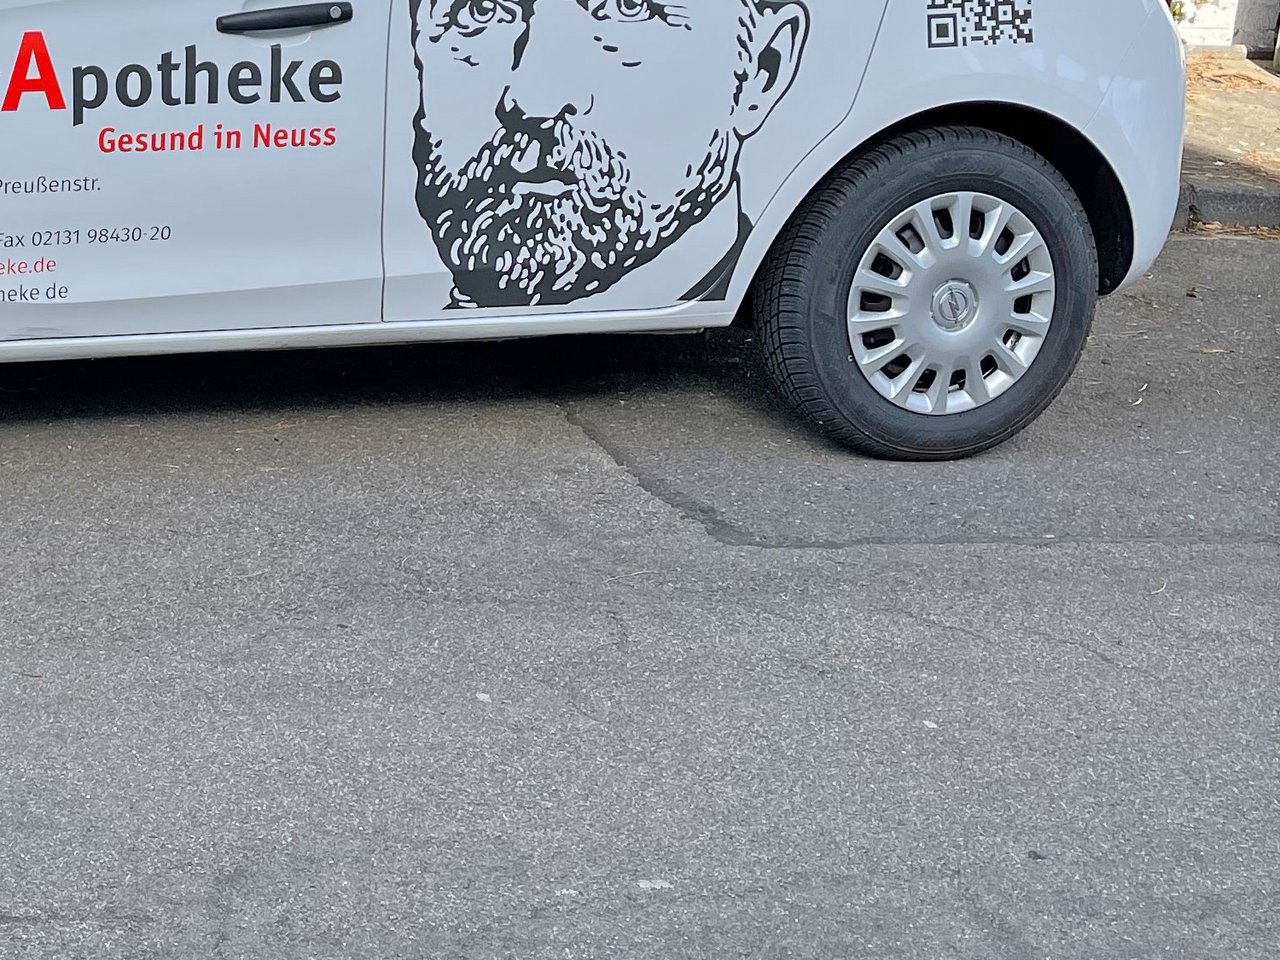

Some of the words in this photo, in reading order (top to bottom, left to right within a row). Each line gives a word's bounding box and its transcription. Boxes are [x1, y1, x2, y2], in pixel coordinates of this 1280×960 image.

[97, 125, 204, 154] Gesund
[214, 123, 242, 150] in
[252, 122, 337, 149] Neuss
[31, 229, 80, 247] 02131
